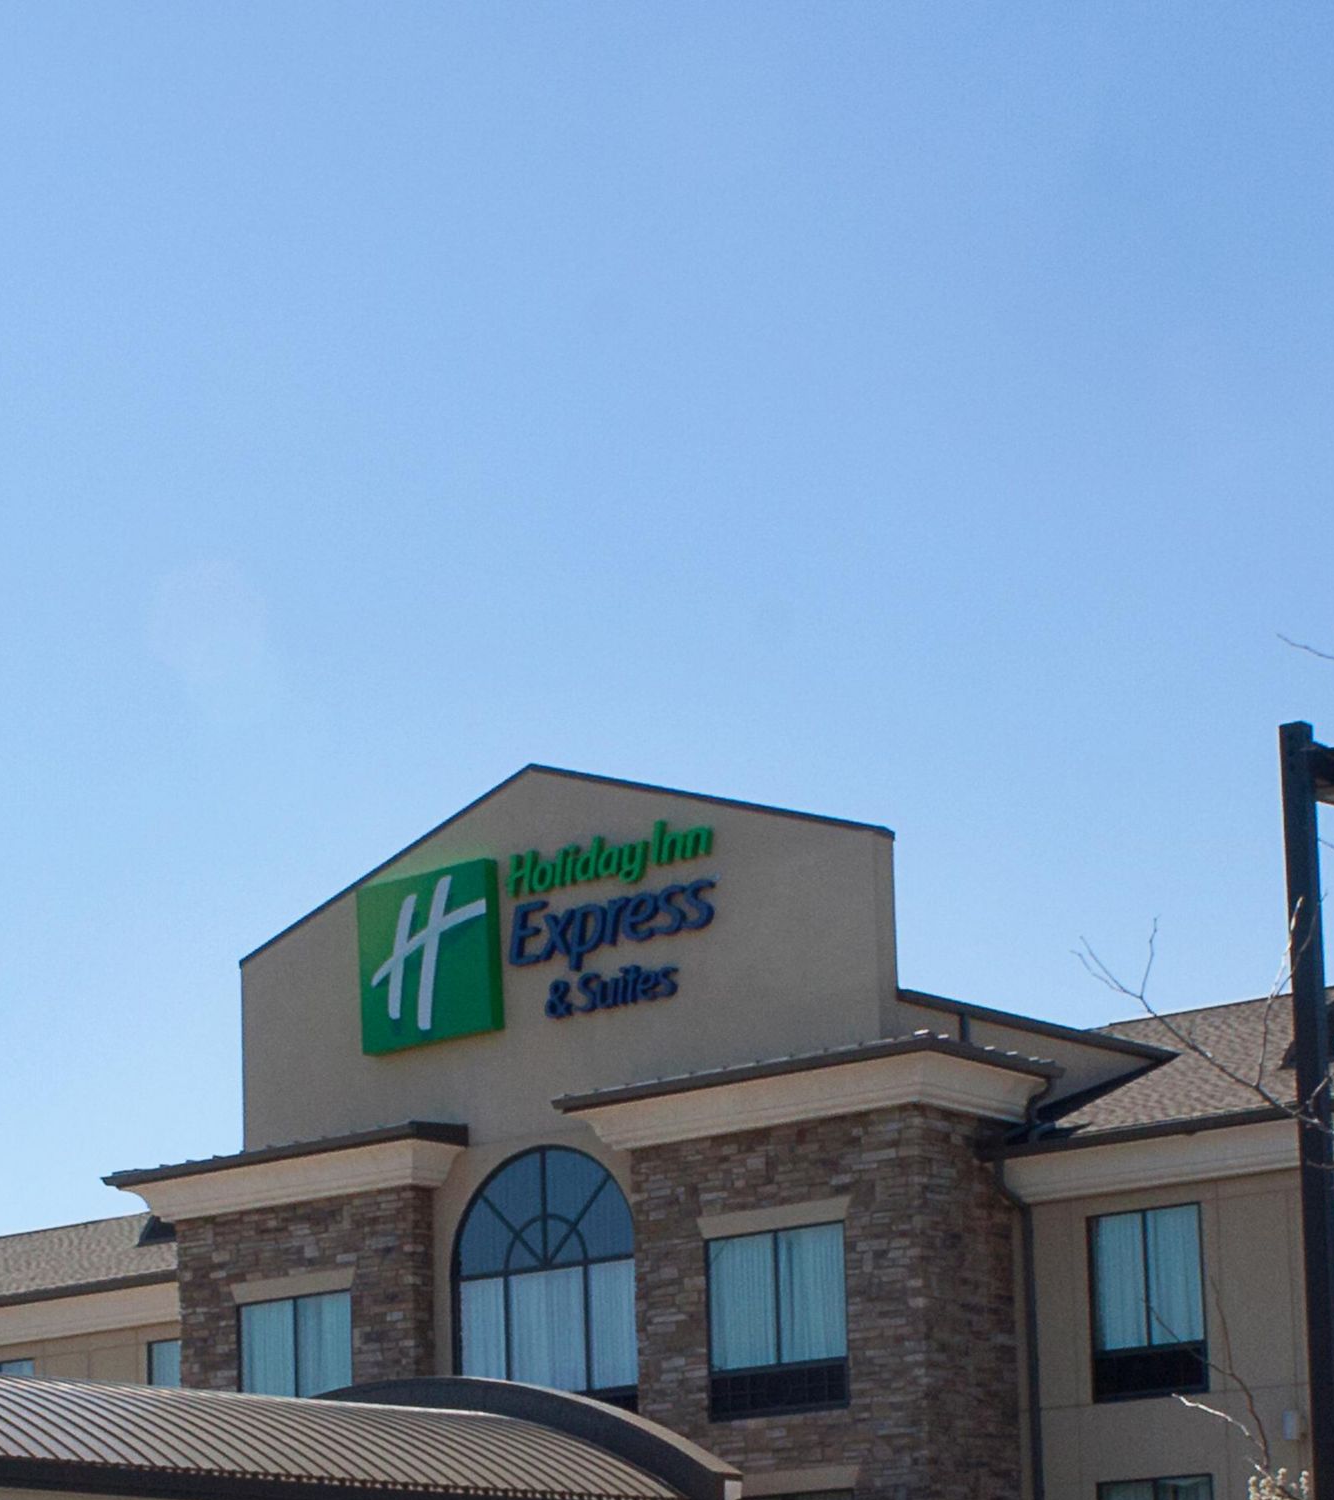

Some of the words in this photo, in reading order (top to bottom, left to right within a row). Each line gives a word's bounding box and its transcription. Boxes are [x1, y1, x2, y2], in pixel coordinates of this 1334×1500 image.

[505, 835, 650, 897] Holiday
[651, 819, 714, 866] Inn
[508, 879, 716, 972] Express
[545, 979, 574, 1019] &
[576, 964, 679, 1013] Suites
